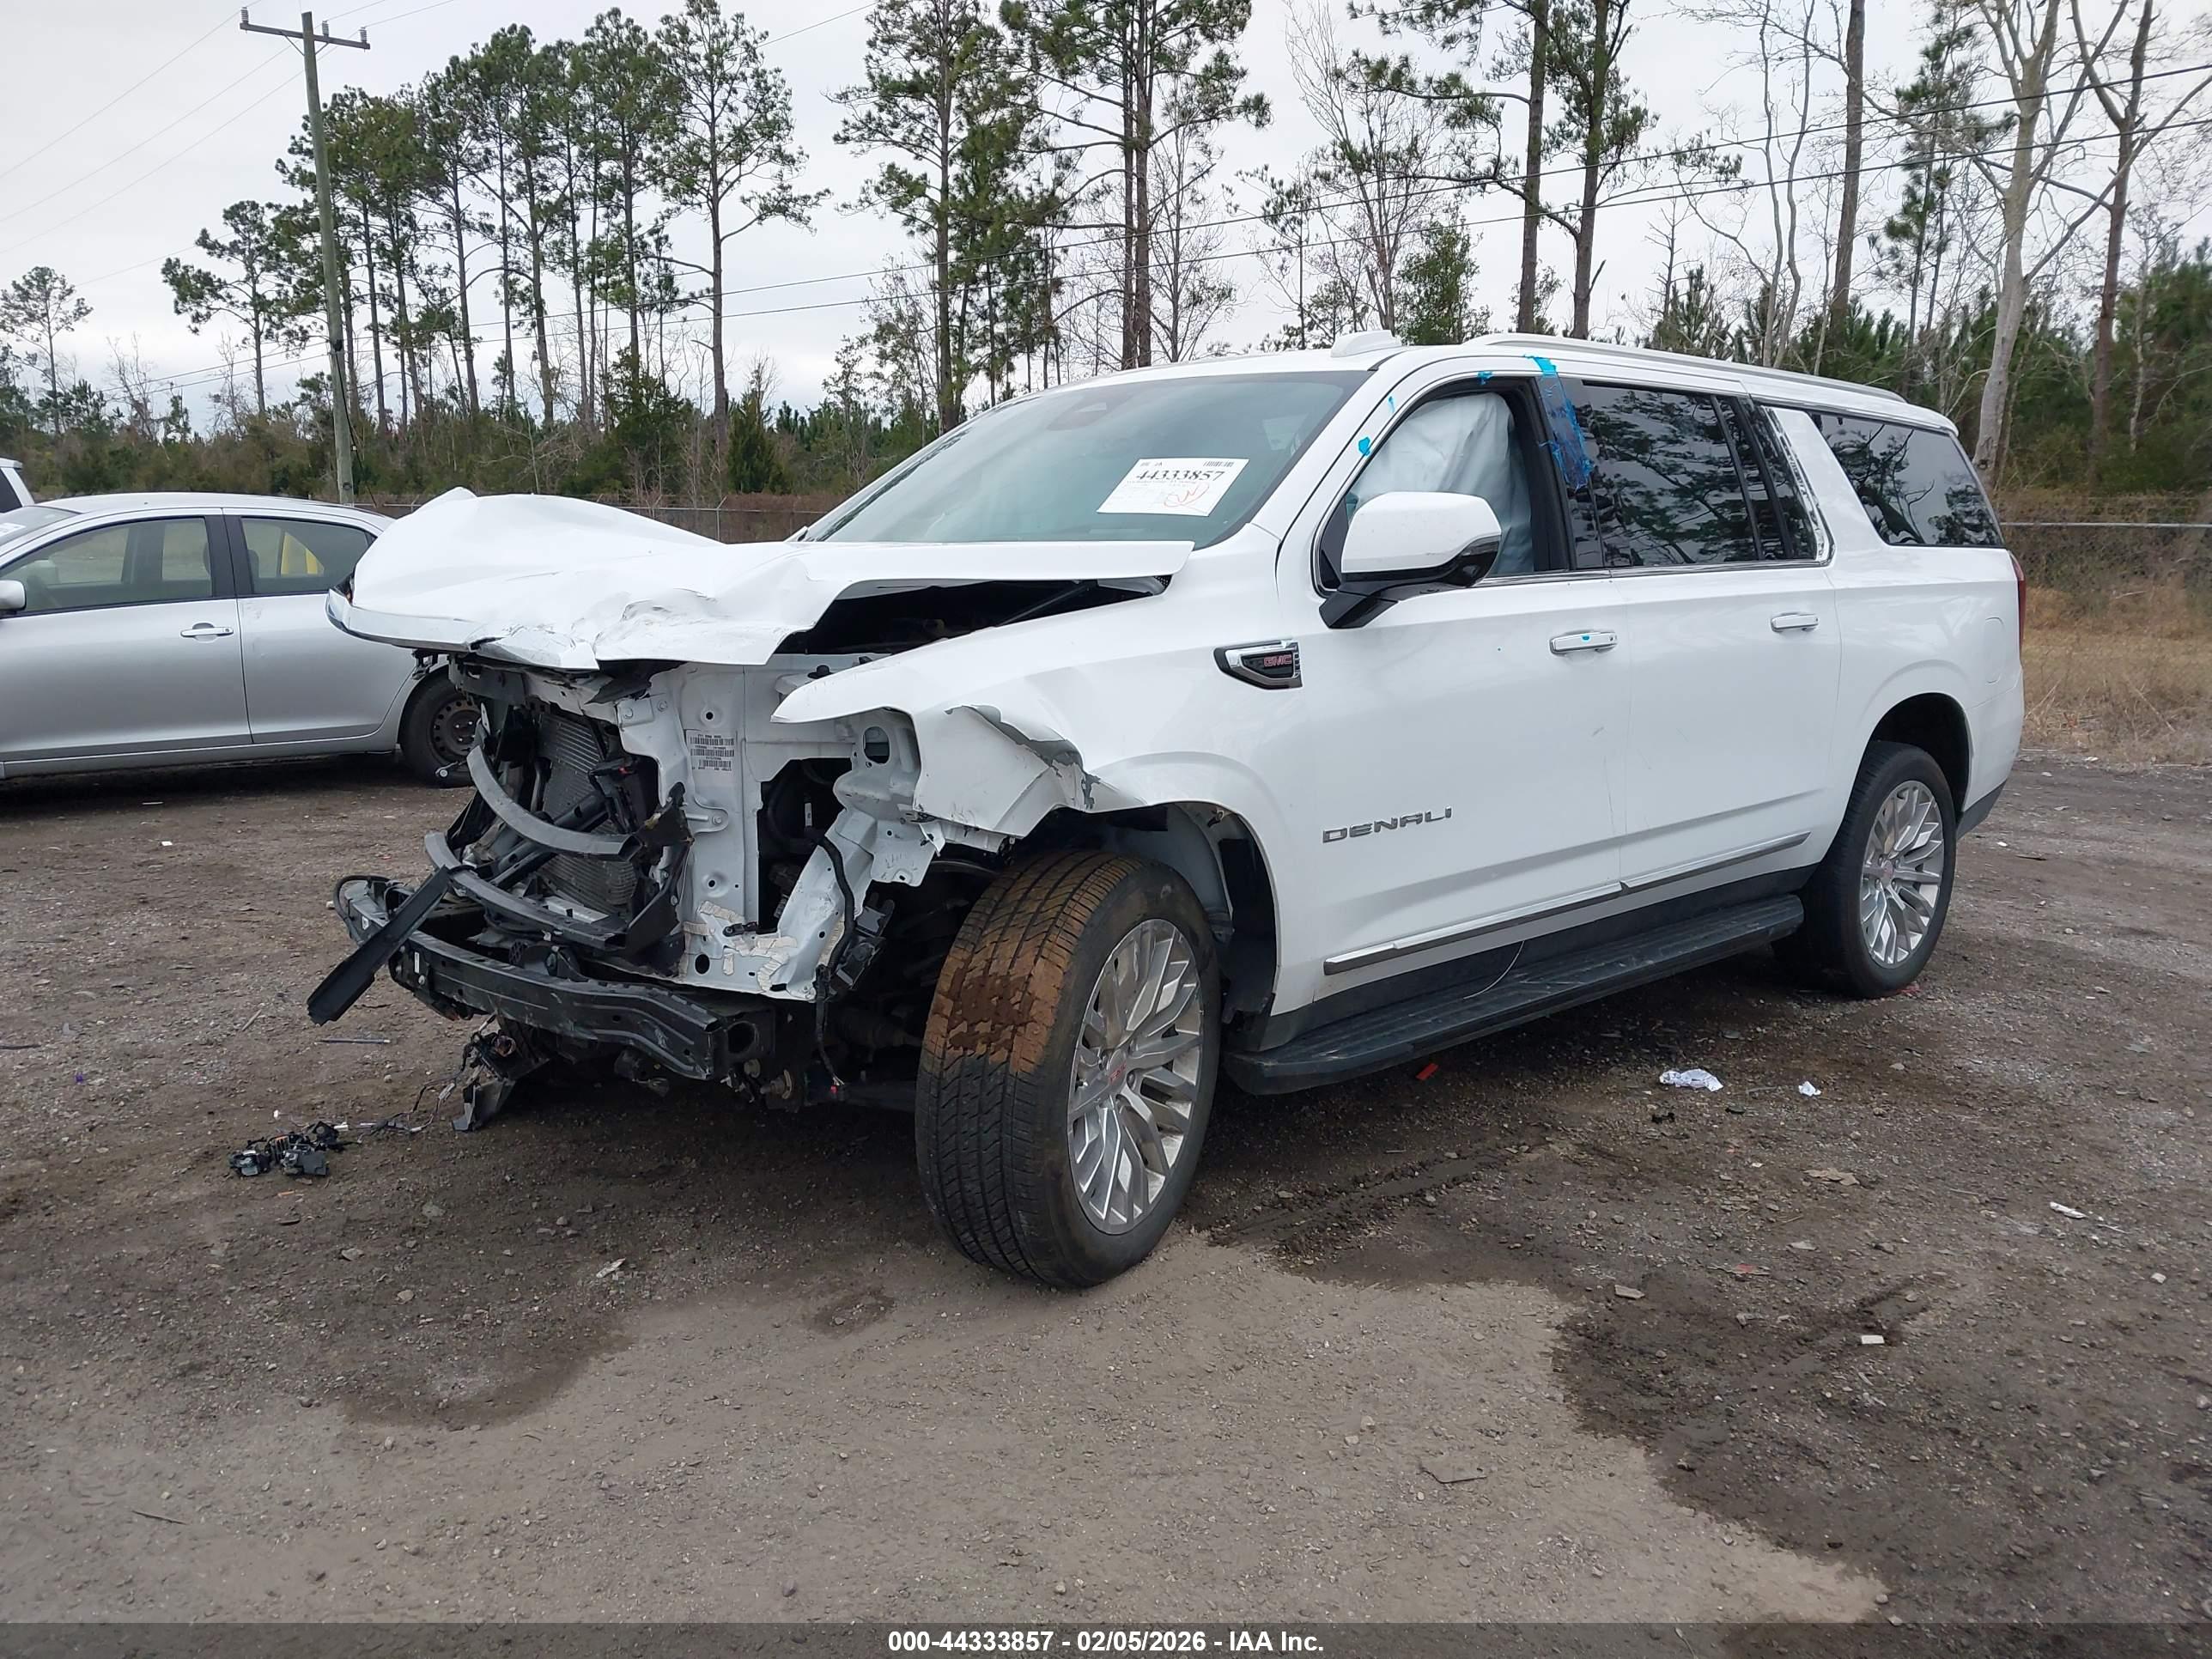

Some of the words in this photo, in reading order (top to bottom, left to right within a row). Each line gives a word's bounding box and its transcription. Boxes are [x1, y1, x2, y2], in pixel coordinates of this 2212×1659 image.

[1136, 470, 1225, 481] 44333857
[1264, 654, 1292, 667] GMC
[1322, 805, 1452, 843] DENALI
